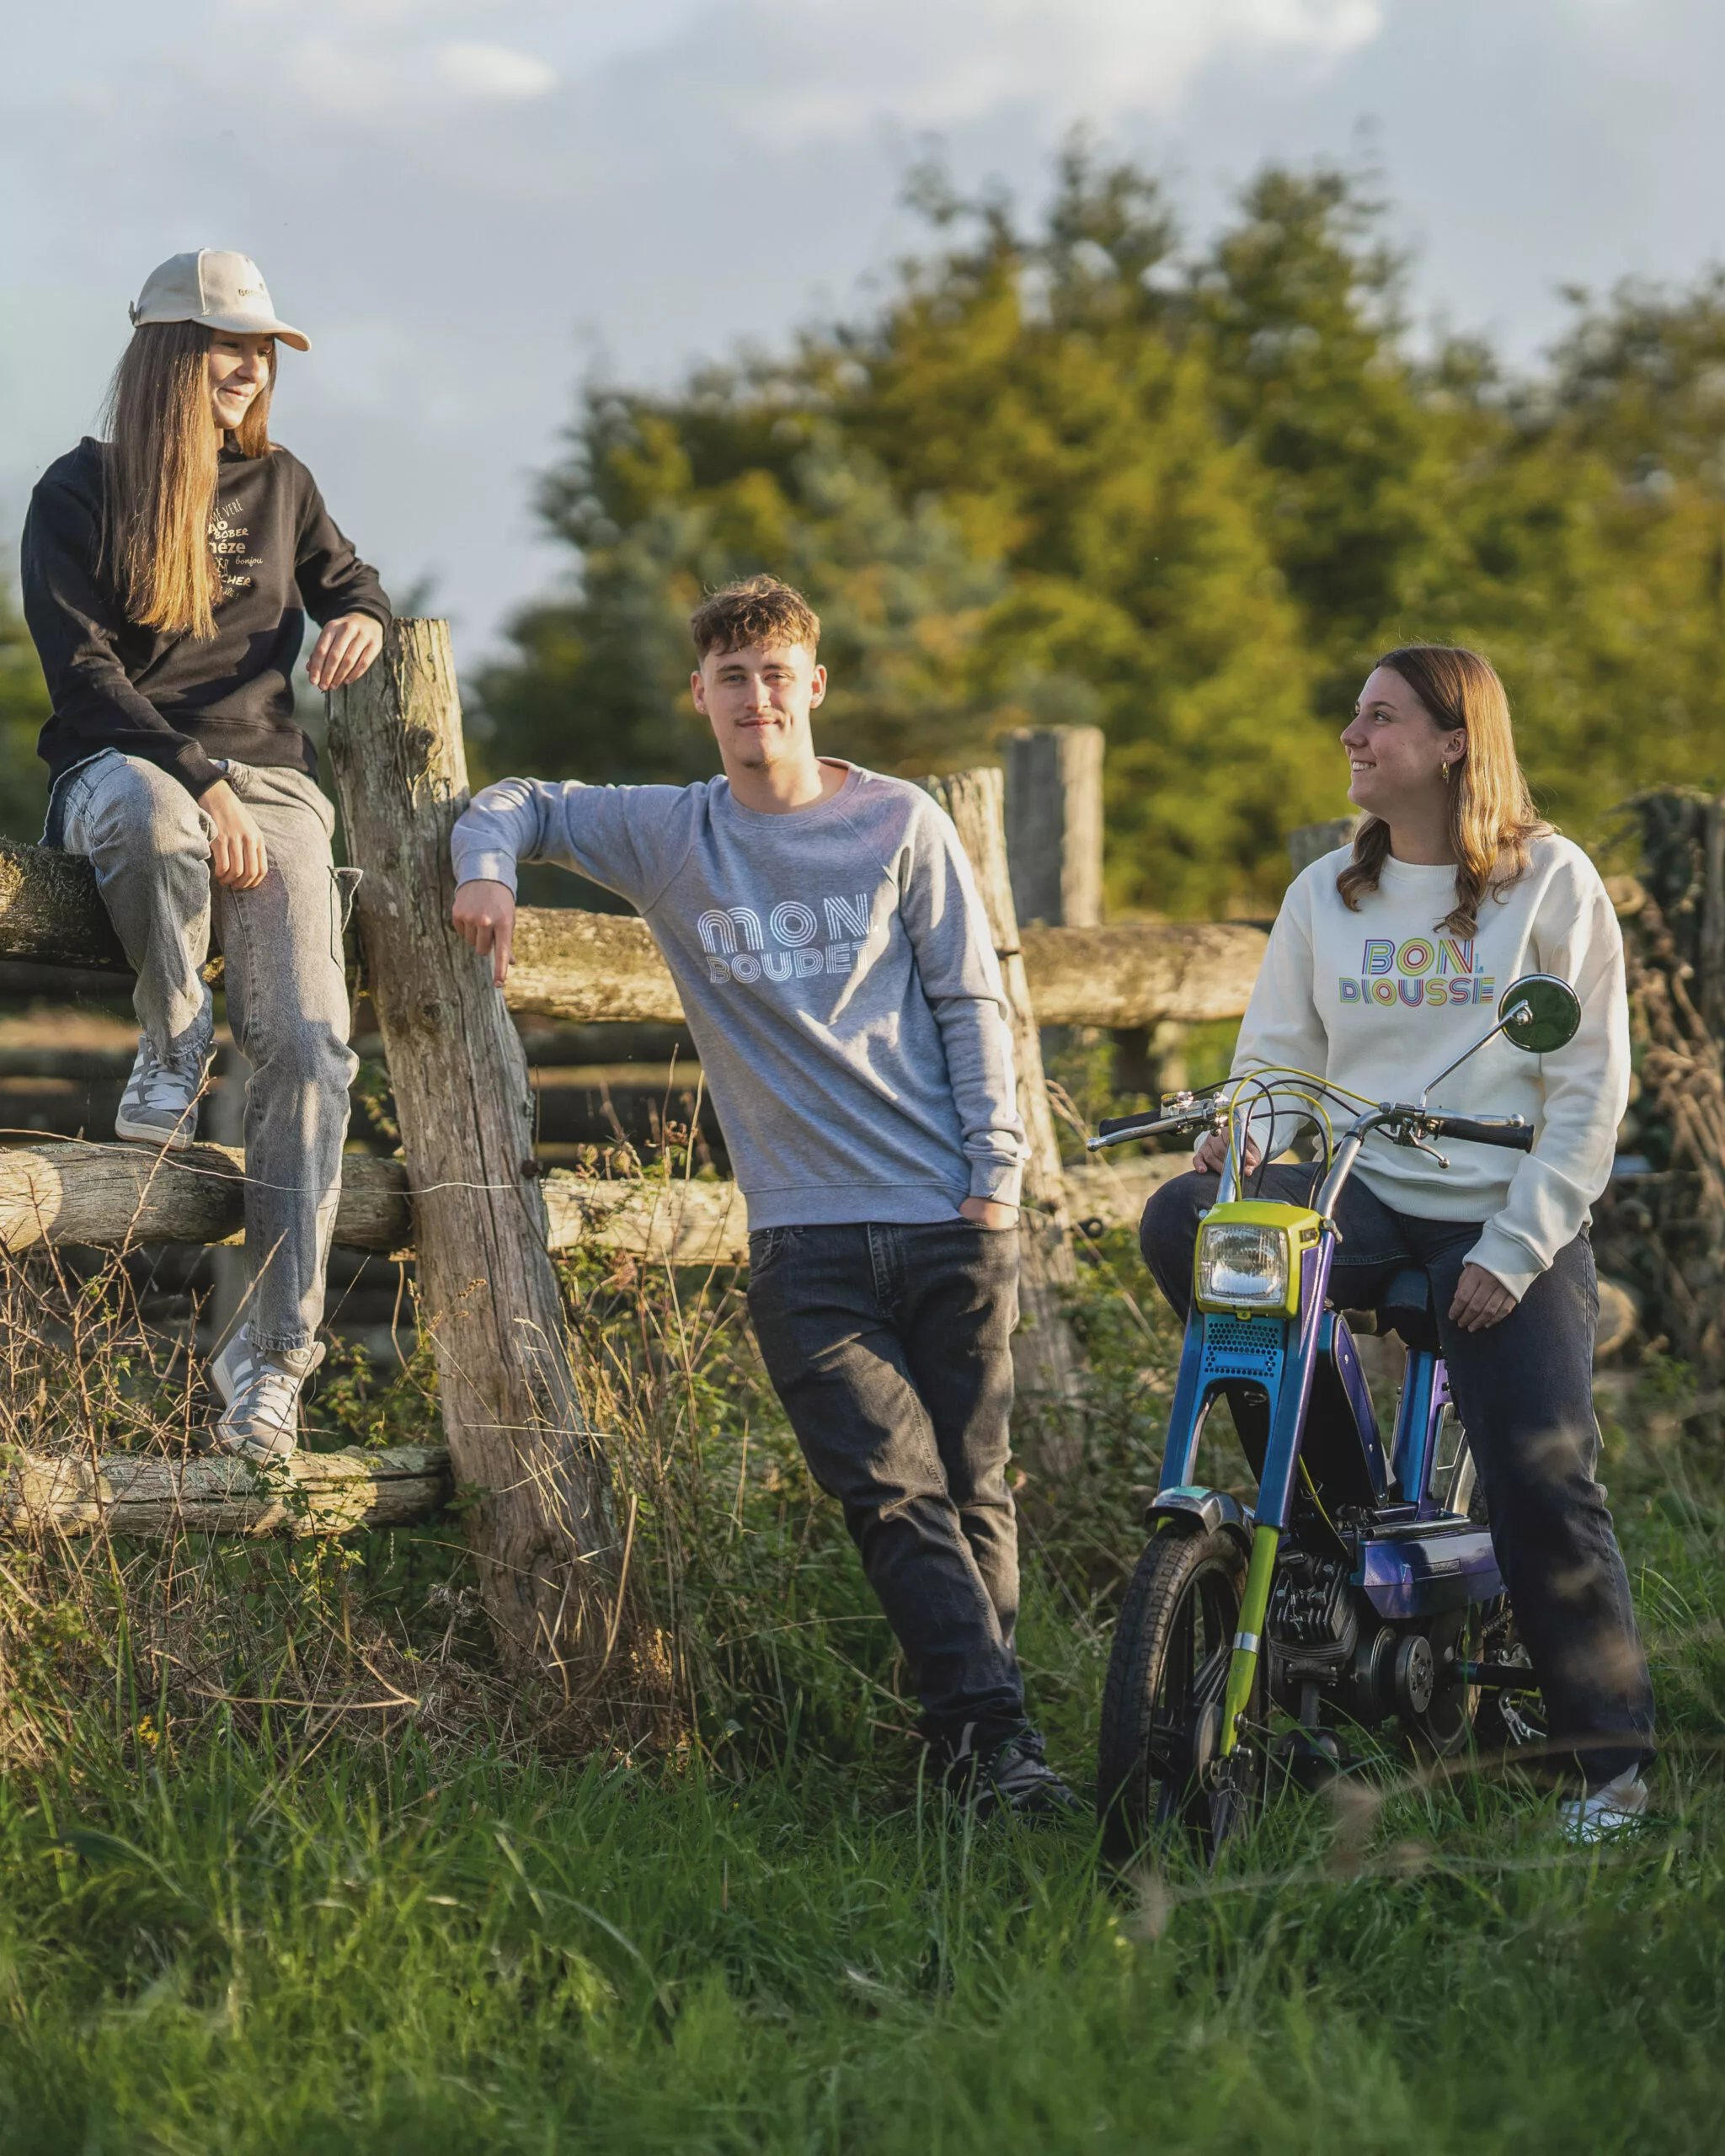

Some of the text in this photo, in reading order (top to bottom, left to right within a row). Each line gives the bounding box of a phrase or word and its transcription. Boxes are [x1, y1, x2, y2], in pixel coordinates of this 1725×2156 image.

[222, 498, 243, 517] VERE
[218, 574, 252, 588] CHER
[697, 893, 870, 953] MON
[706, 939, 870, 984] BOUDET
[1362, 937, 1474, 977] BON
[1338, 977, 1496, 1007] DIOUSSE
